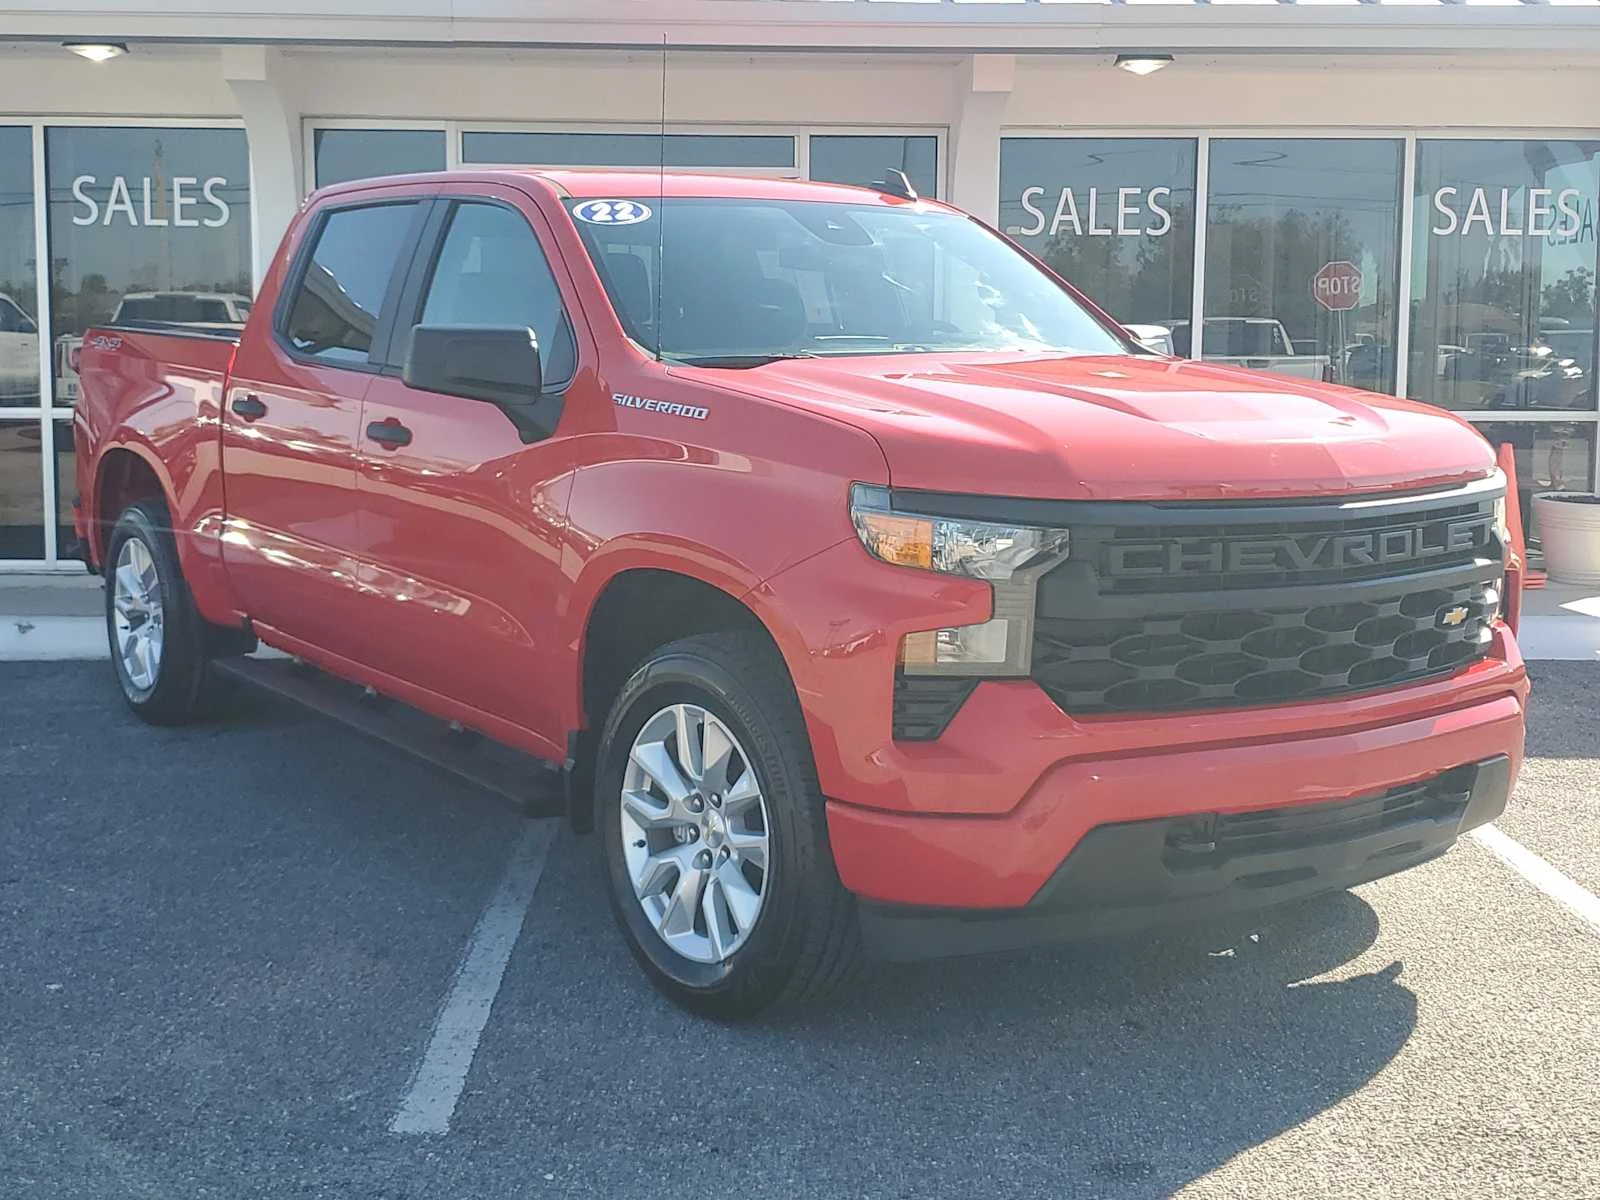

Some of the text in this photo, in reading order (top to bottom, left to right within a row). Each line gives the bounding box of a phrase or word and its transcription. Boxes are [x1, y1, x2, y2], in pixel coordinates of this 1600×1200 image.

[72, 175, 231, 228] SALES
[591, 202, 635, 222] 22
[1020, 186, 1172, 237] SALES
[1432, 186, 1581, 236] SALES
[612, 392, 709, 420] SILVERADO
[1109, 517, 1497, 576] CHEVROLET
